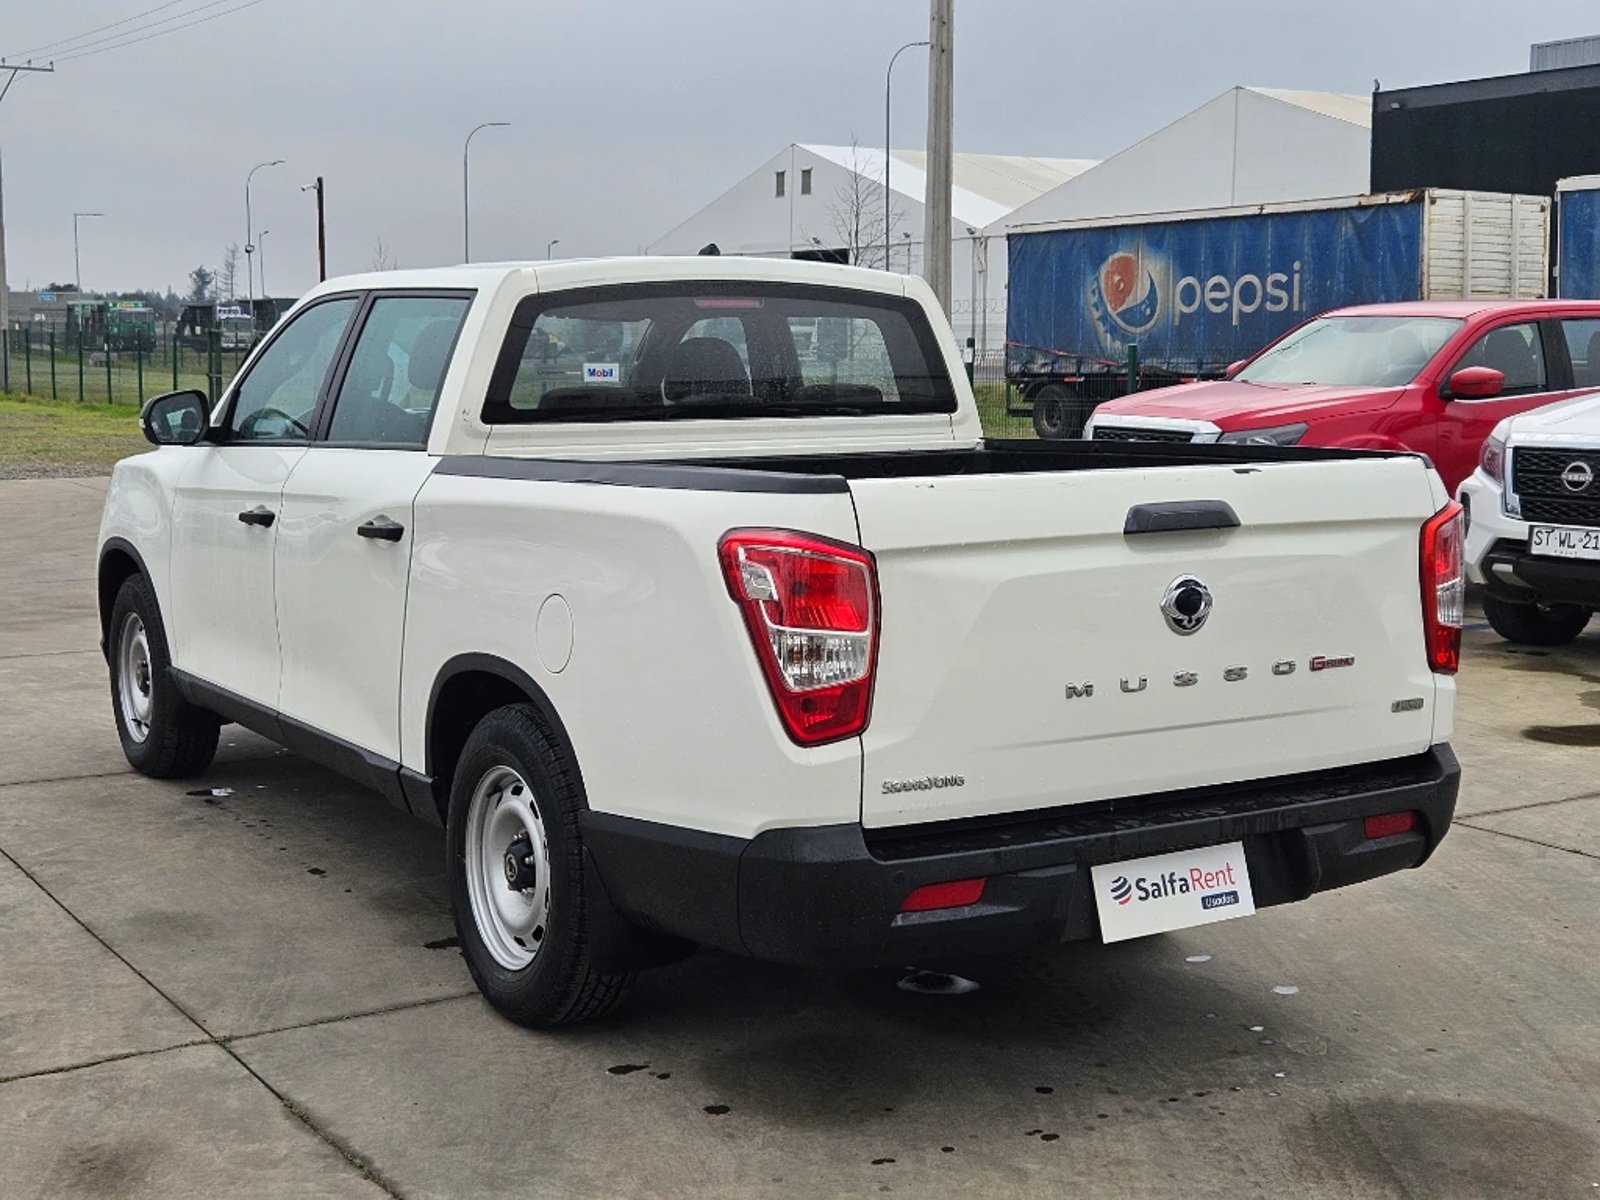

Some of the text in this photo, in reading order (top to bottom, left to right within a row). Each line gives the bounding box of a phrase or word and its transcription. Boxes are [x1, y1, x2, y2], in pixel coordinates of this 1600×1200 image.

[1173, 260, 1302, 326] pepsi
[587, 368, 614, 377] Mobil
[1534, 529, 1555, 546] ST
[1558, 531, 1576, 549] WL
[1065, 658, 1296, 699] MUSSO
[1135, 862, 1237, 902] SalfaRent
[1205, 893, 1236, 907] Usados
